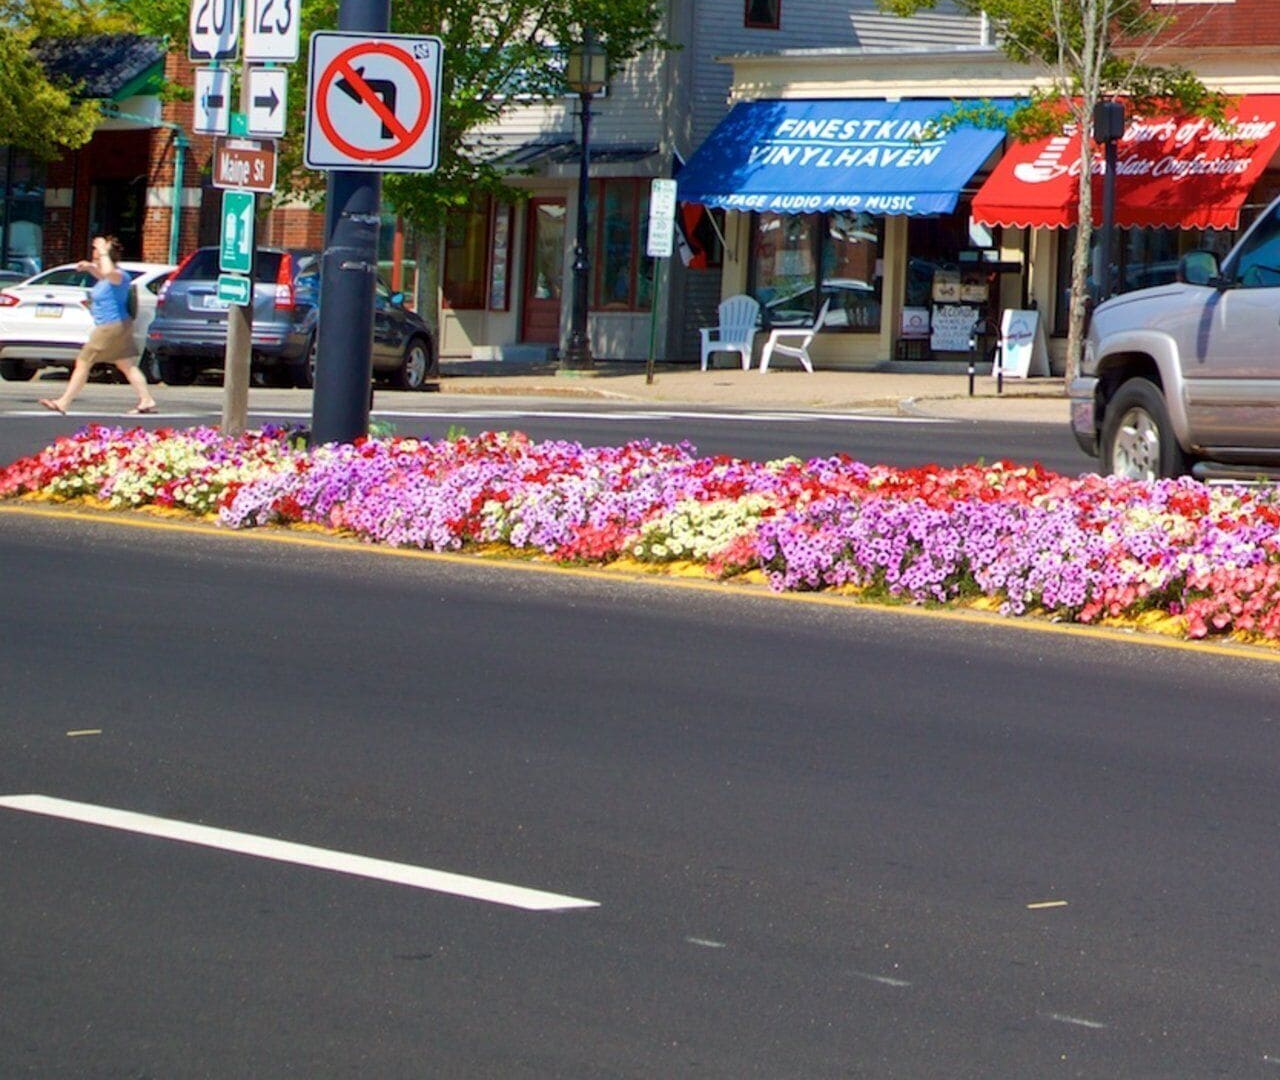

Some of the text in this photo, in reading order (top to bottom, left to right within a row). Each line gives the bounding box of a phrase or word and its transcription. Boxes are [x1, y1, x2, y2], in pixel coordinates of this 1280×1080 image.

[749, 146, 942, 167] VINYLHAVEN
[220, 153, 264, 183] Maine St
[769, 195, 819, 209] AUDIO
[825, 195, 861, 209] AND
[865, 196, 915, 210] MUSIC
